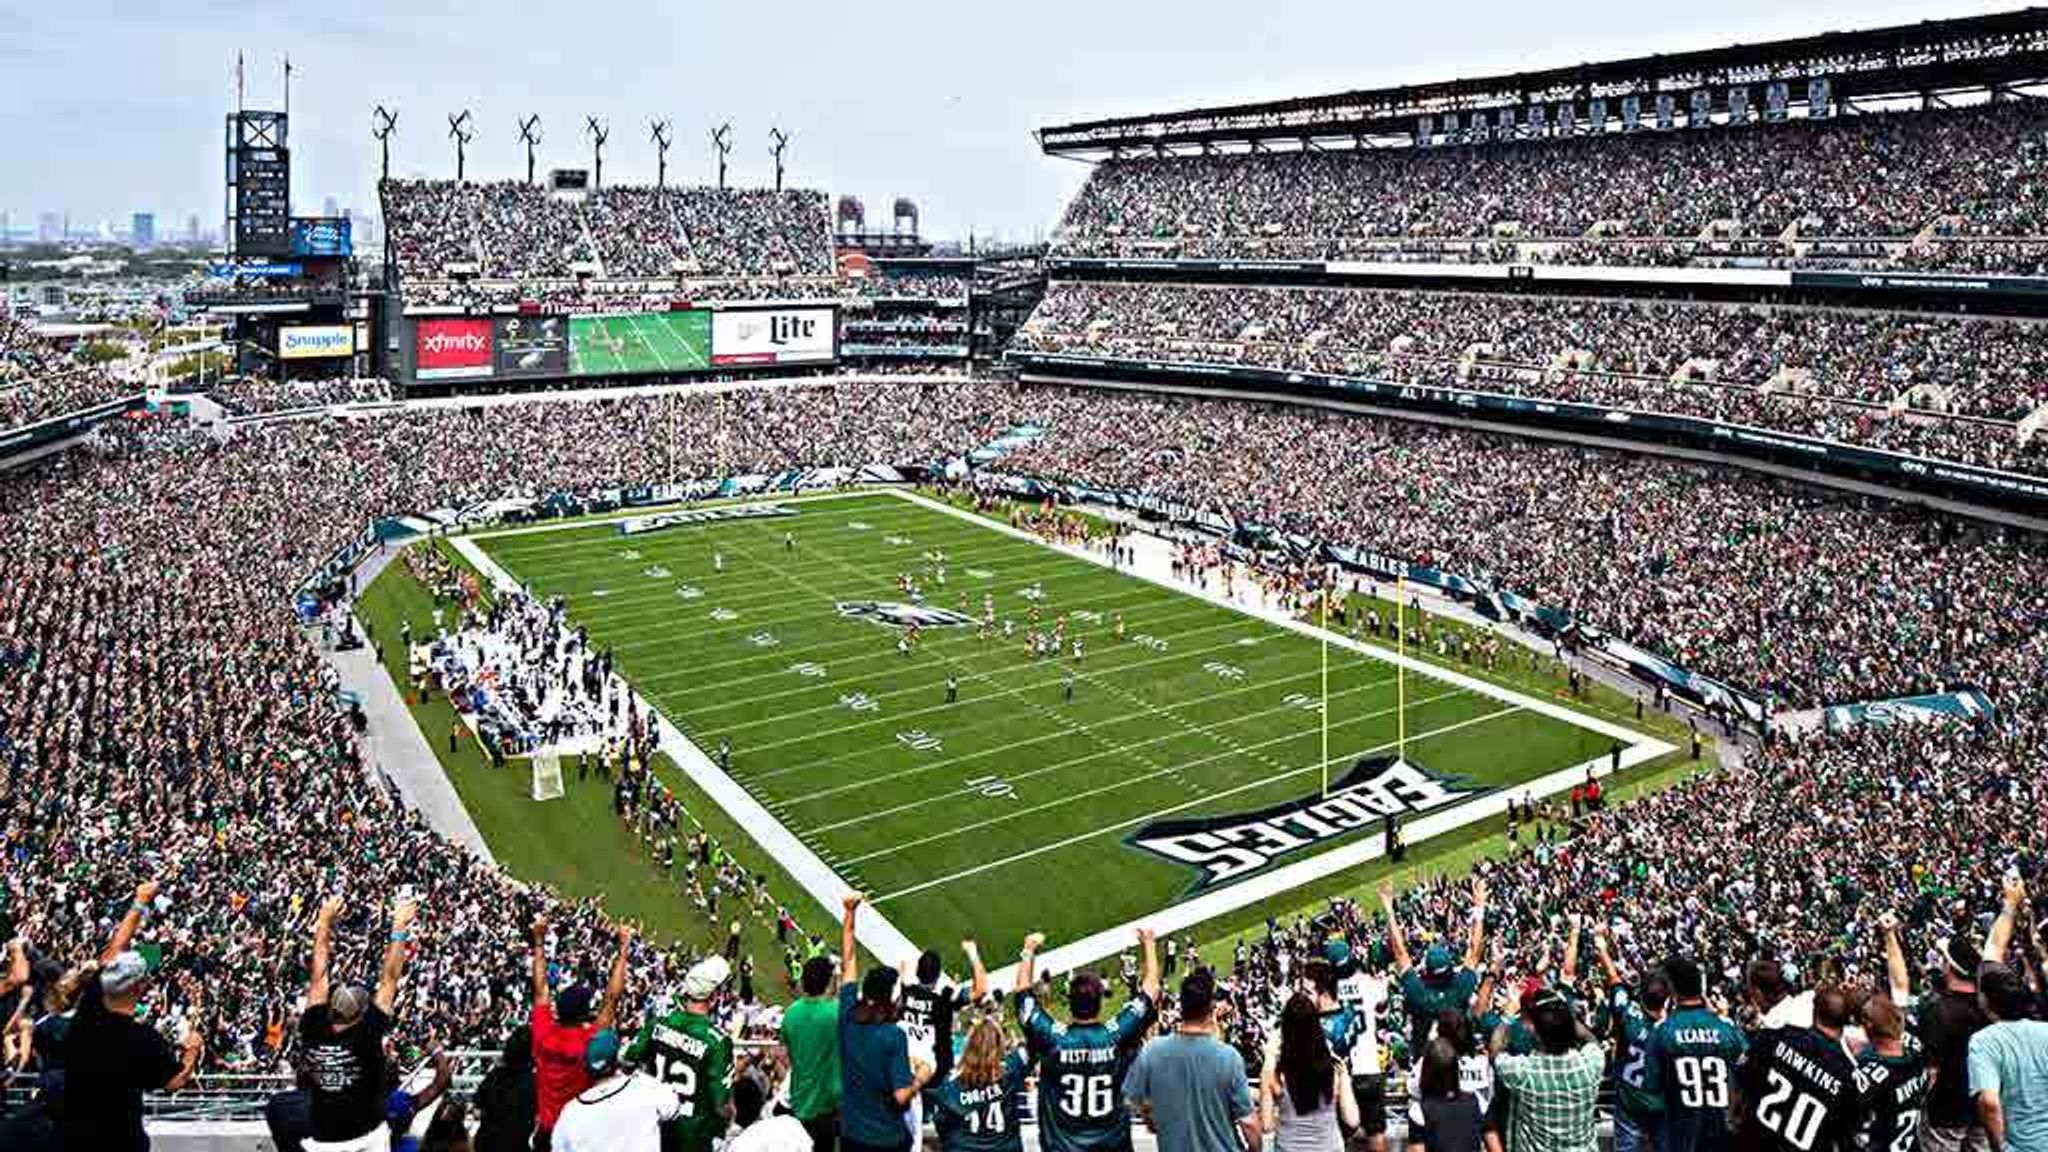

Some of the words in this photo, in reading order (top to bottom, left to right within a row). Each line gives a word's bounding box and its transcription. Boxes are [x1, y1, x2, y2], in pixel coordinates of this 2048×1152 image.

[286, 332, 347, 349] Snapple
[769, 315, 815, 345] Lite
[1622, 1045, 1646, 1089] 2
[1675, 1056, 1729, 1107] 93
[1774, 1041, 1843, 1096] DAWKINS
[964, 1101, 1005, 1133] 14
[1060, 1073, 1113, 1117] 36
[1756, 1067, 1828, 1151] 20
